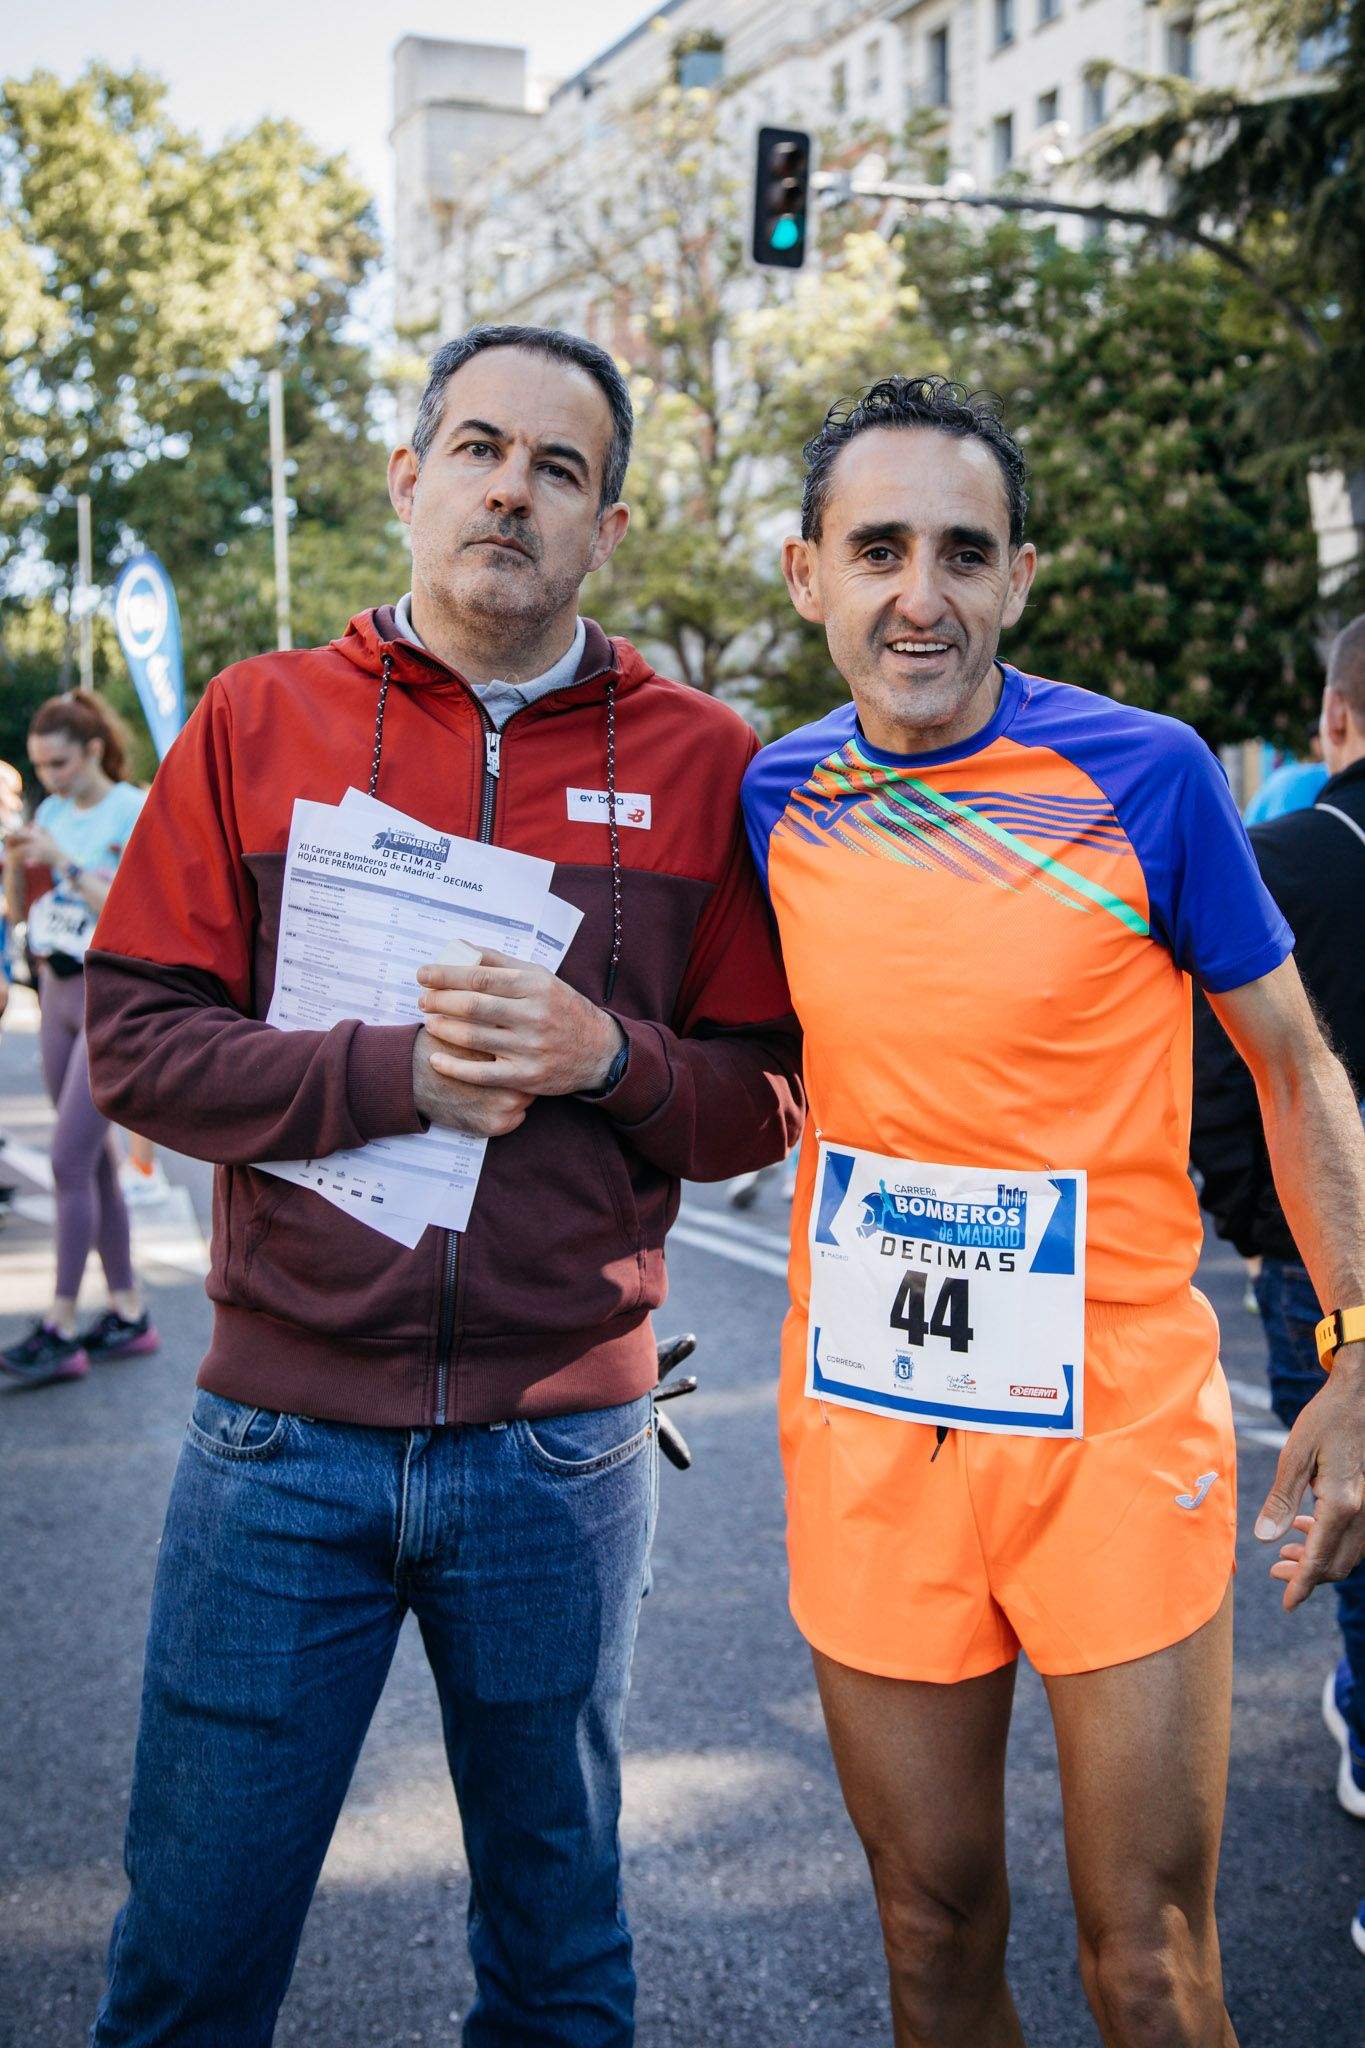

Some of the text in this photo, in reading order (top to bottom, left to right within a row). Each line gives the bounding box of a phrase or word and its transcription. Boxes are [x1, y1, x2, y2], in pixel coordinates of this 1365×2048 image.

[393, 834, 448, 854] BOMBEROS
[420, 849, 446, 862] MADRID
[297, 852, 387, 877] HOJA DE PREMIACION
[298, 843, 310, 854] XII
[310, 845, 348, 859] Carrera
[349, 850, 388, 868] Bomberos
[389, 859, 402, 871] de
[403, 863, 434, 880] Madrid
[443, 875, 484, 892] DECIMAS
[382, 849, 442, 871] DECIMAS
[894, 1184, 937, 1198] CARRERA
[895, 1196, 1021, 1227] BOMBEROS
[938, 1223, 1020, 1247] de MADRID
[880, 1236, 1016, 1273] DECIMAS
[889, 1269, 974, 1353] 44
[1022, 1387, 1057, 1398] ENERVIT
